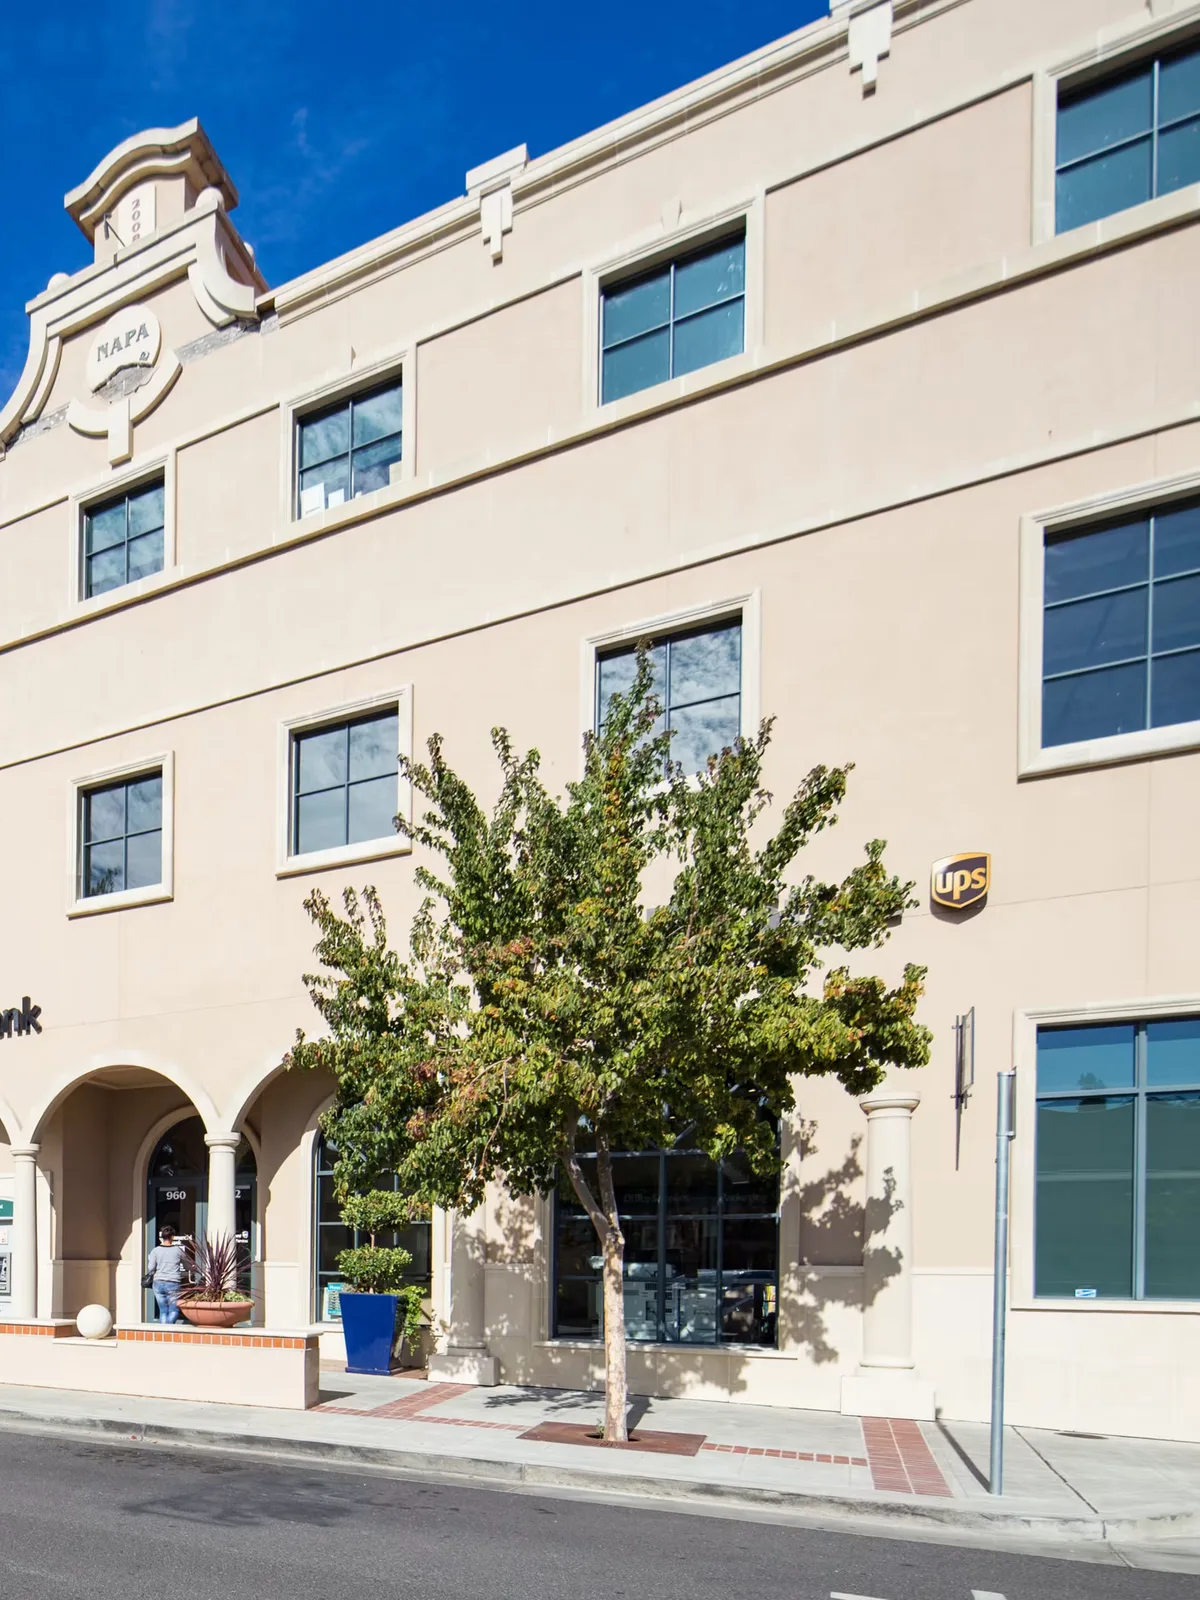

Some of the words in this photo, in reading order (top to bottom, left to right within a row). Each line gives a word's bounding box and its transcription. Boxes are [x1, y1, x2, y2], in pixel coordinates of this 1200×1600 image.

[97, 323, 149, 362] NAPA
[936, 867, 986, 900] ups
[166, 1190, 186, 1200] 960
